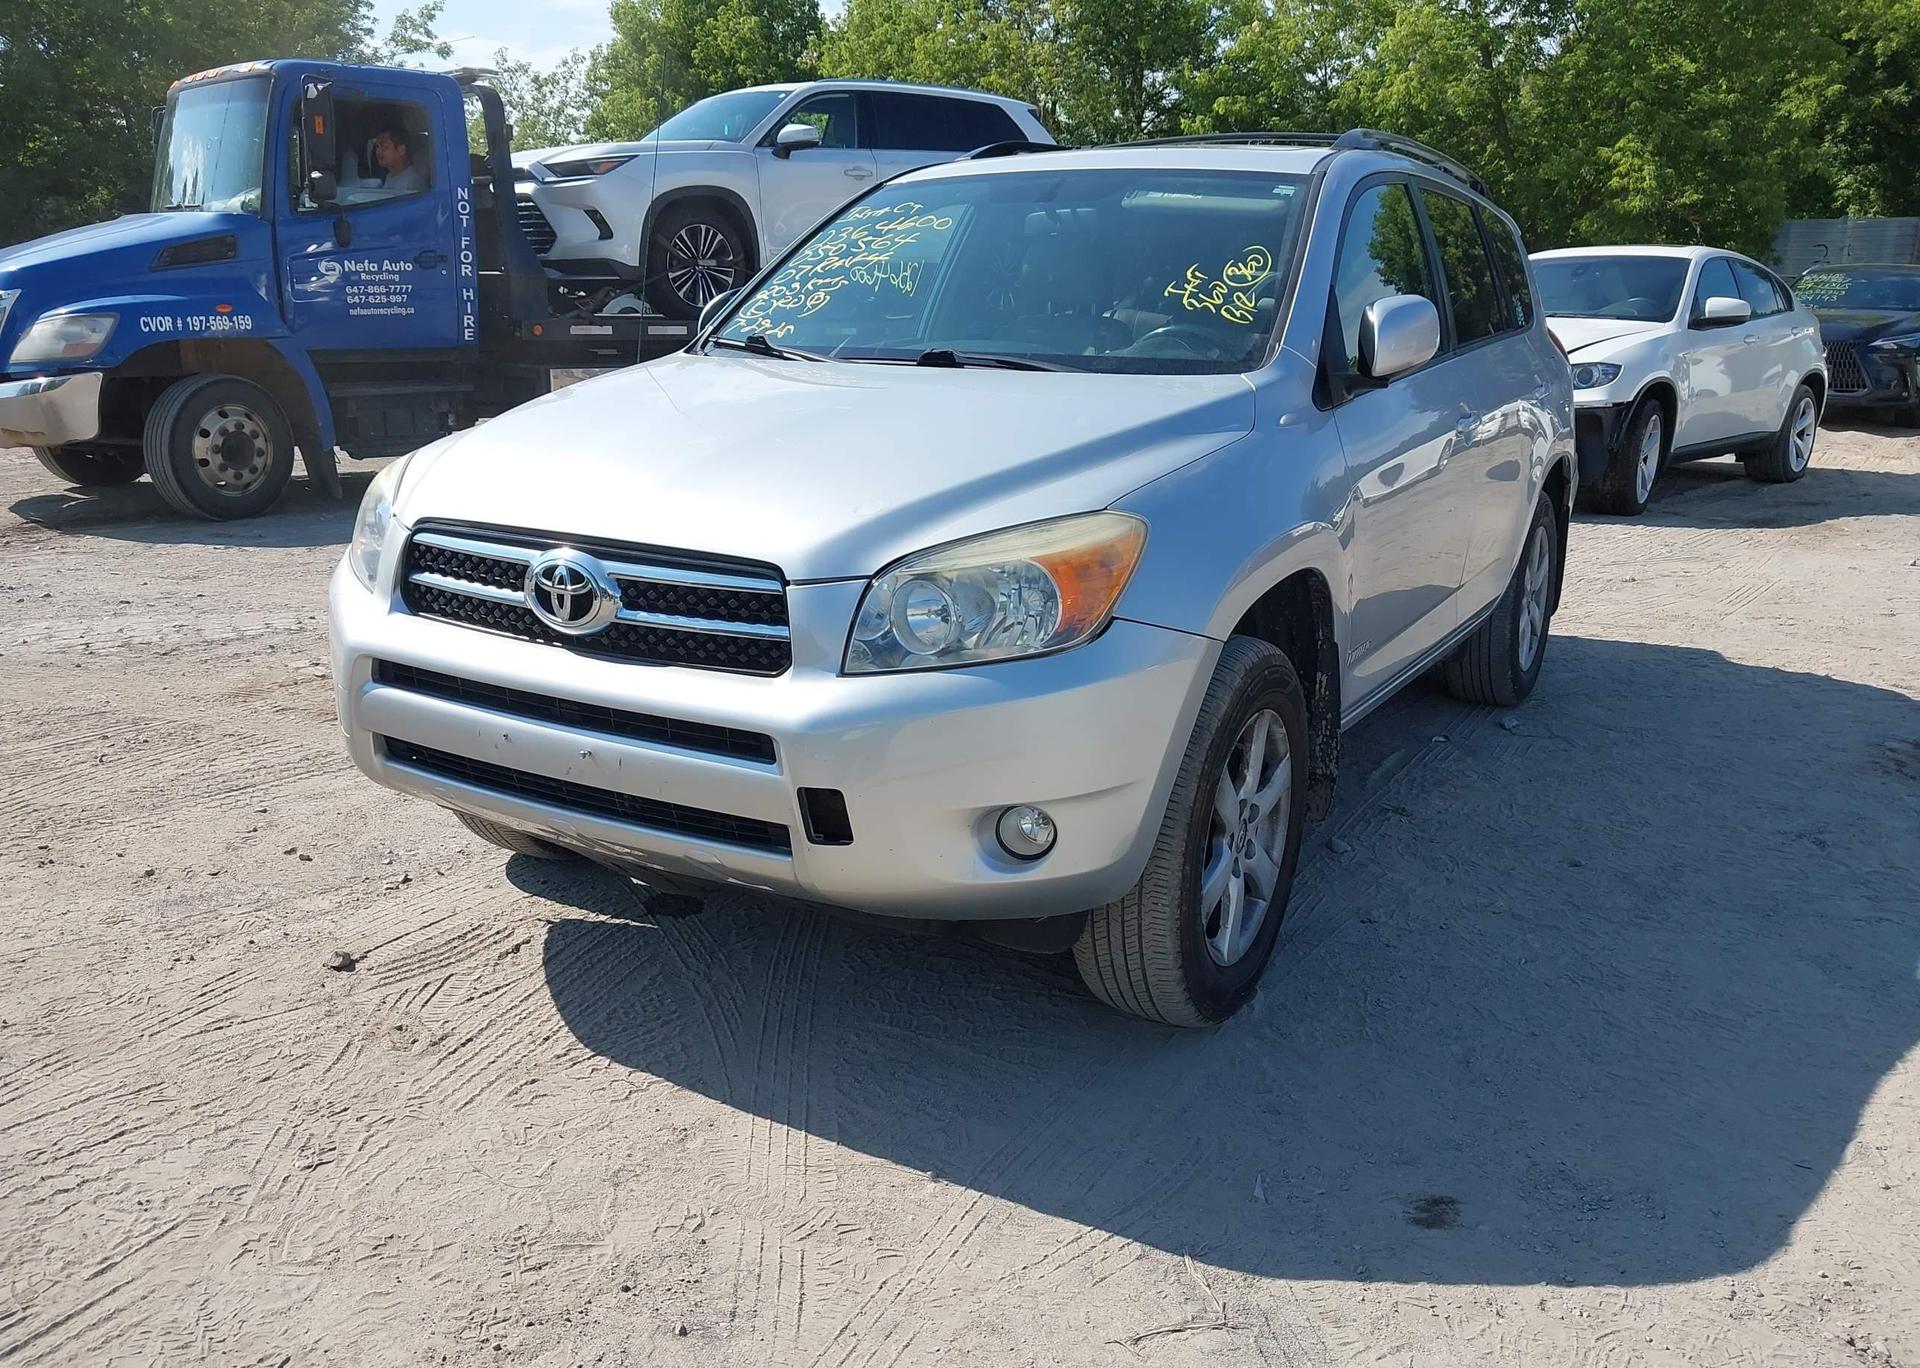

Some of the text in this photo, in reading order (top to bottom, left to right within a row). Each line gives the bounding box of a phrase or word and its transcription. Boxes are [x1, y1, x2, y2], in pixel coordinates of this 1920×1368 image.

[874, 215, 953, 235] 4600
[344, 259, 413, 272] Nefa Auto
[457, 187, 475, 341] NOT FOR HIRE
[360, 272, 400, 282] Recycling
[345, 285, 413, 294] 647-866-7777
[349, 306, 415, 316] nefaautorecycling.ca
[140, 314, 252, 333] CVOR # 197-569-159
